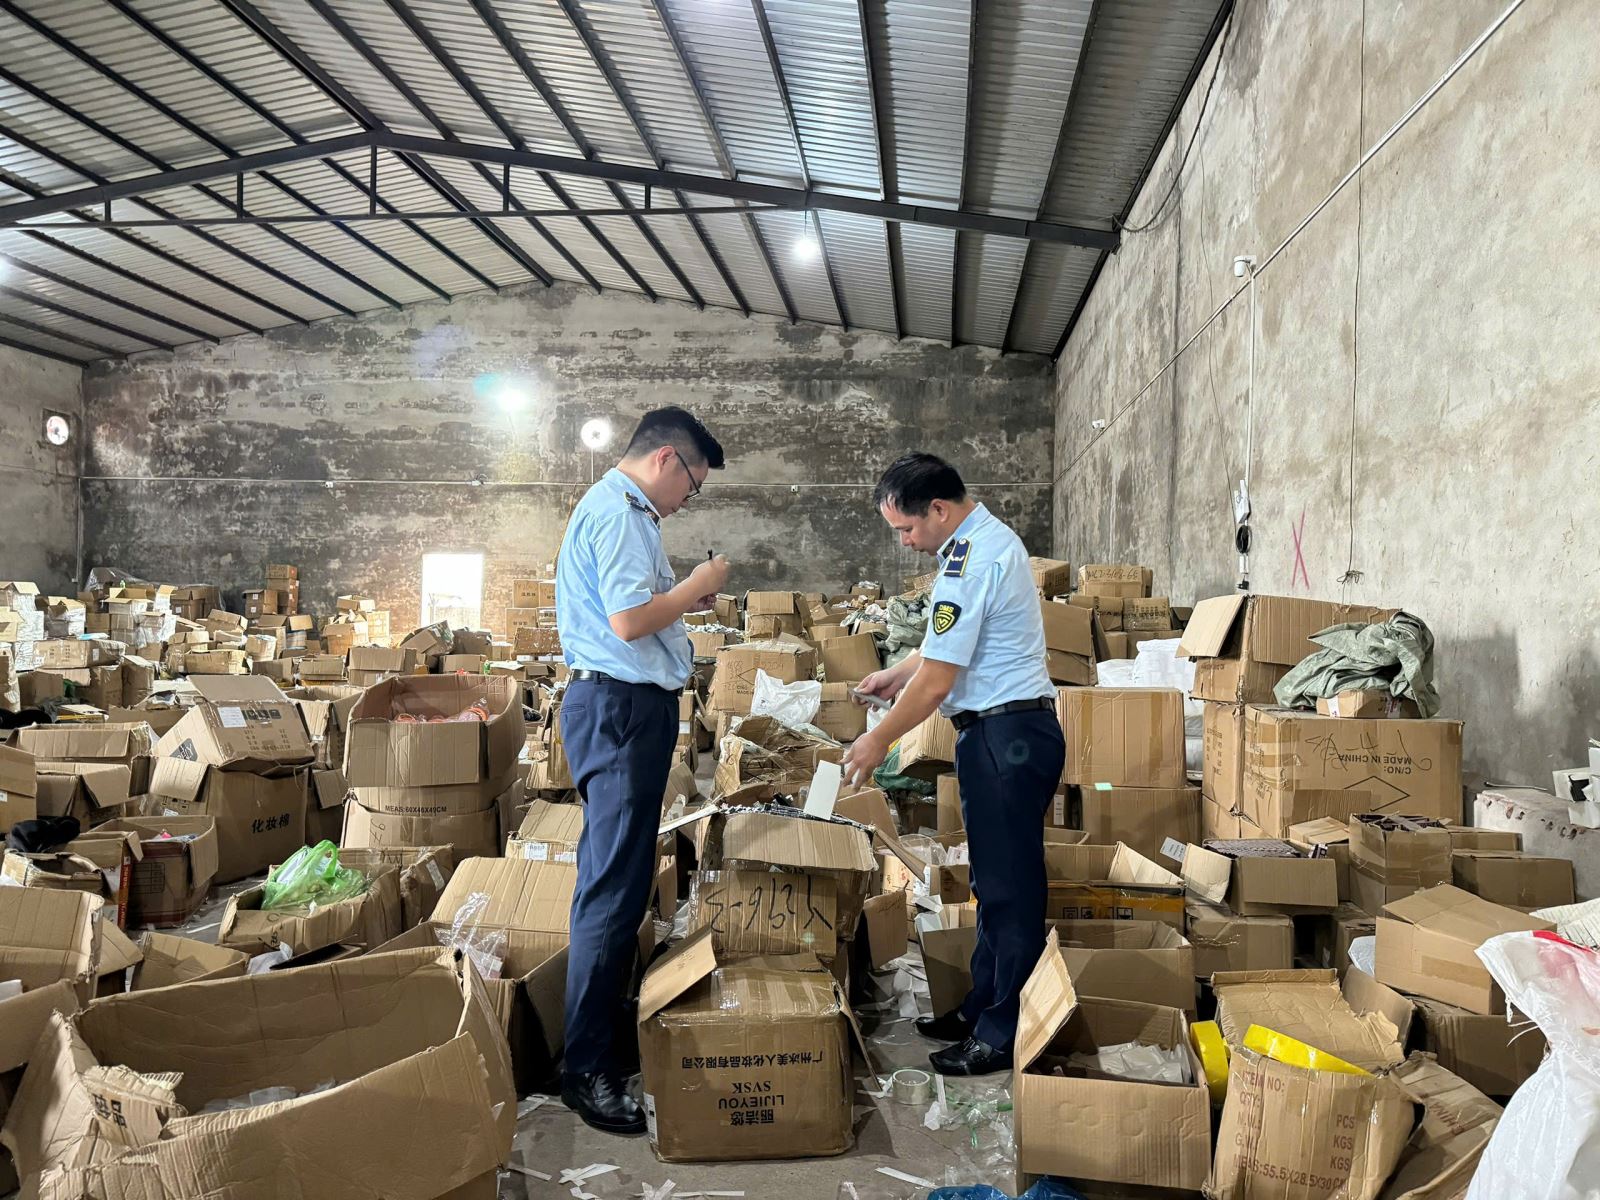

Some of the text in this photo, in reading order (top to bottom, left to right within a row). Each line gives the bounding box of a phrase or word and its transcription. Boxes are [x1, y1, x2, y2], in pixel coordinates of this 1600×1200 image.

[938, 604, 955, 613] DMS
[1338, 753, 1412, 766] MADE IN CHINA
[1384, 765, 1412, 775] C/NO:
[681, 1051, 824, 1069] 广州冰美人化妆品有限公司
[732, 1081, 772, 1094] SVSK
[1266, 1076, 1285, 1093] NO:
[718, 1095, 785, 1110] LIJIEYOU
[729, 1109, 774, 1126] 丽洁悠
[1336, 1114, 1356, 1129] PCS
[1333, 1135, 1353, 1150] KGS
[1330, 1155, 1351, 1171] KGS
